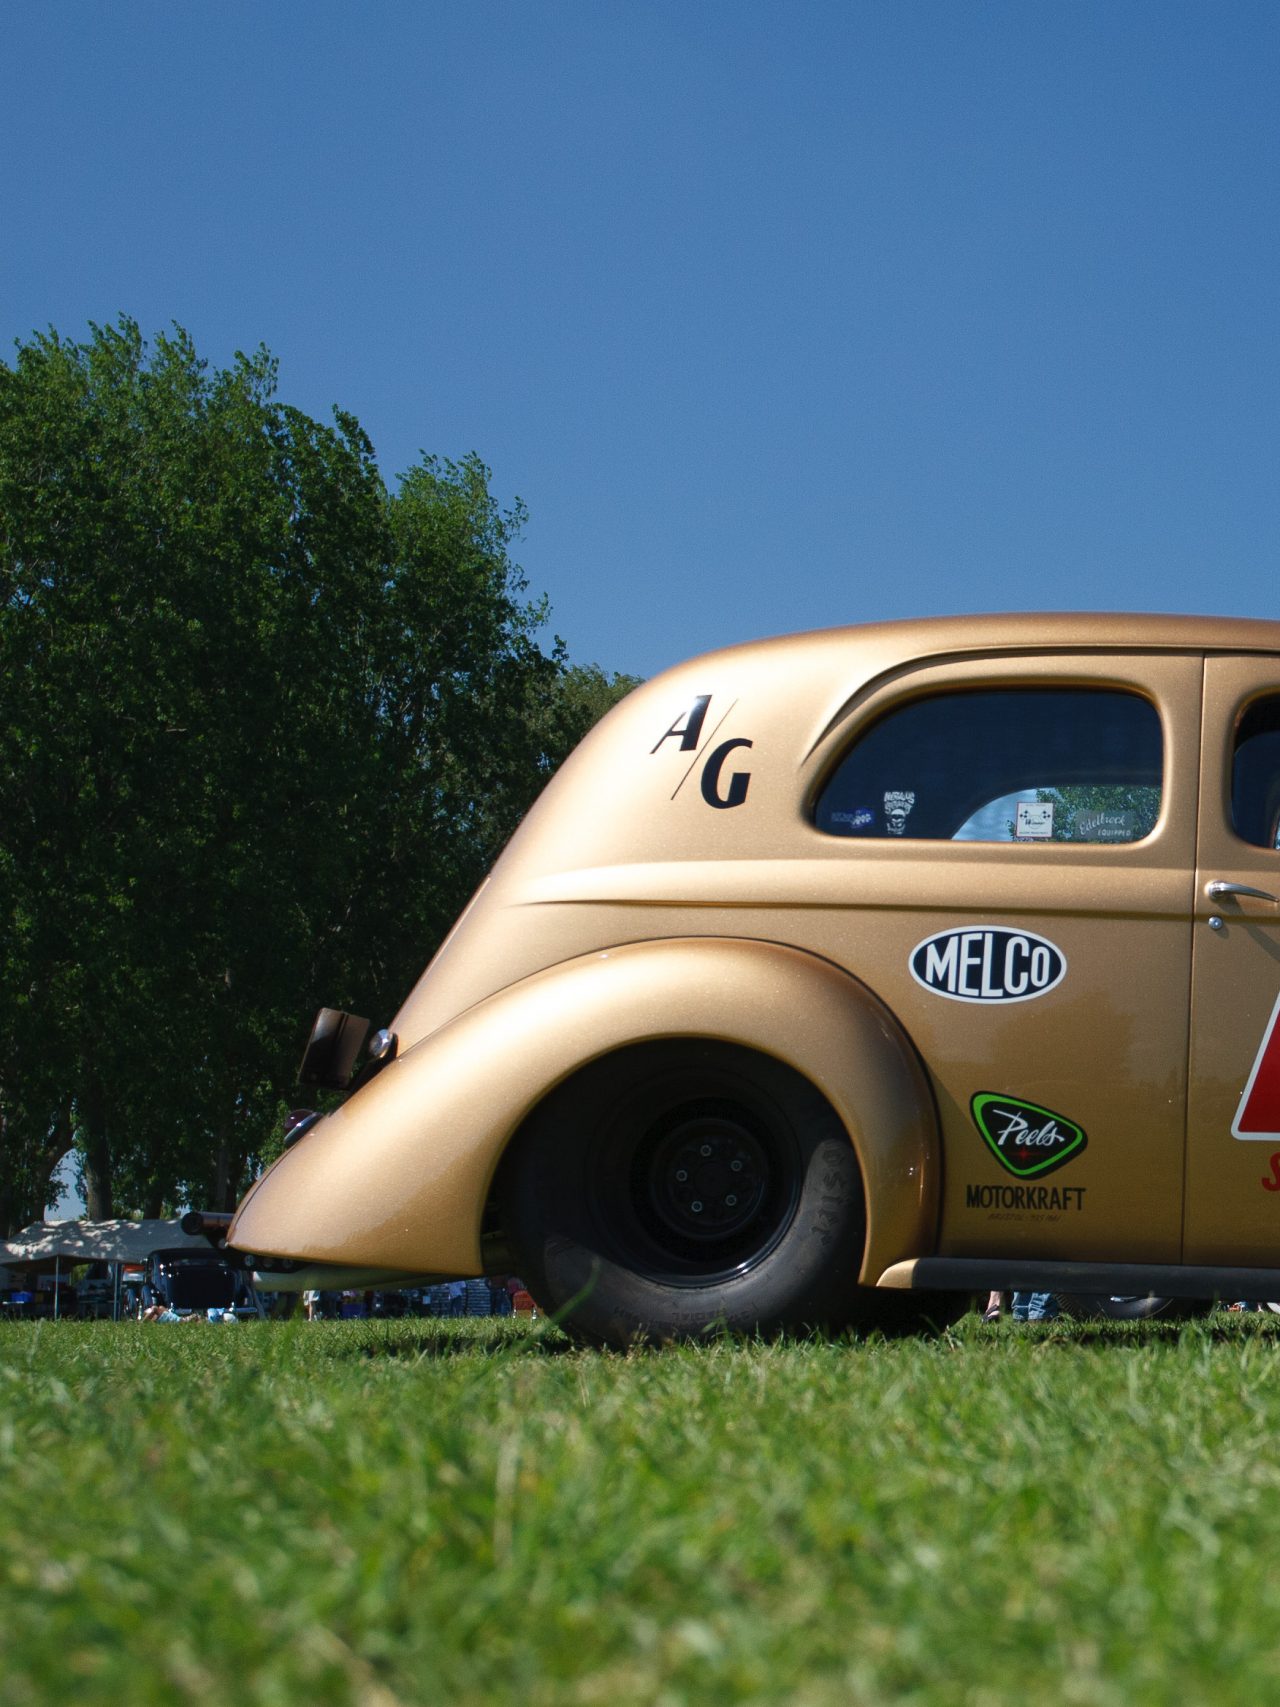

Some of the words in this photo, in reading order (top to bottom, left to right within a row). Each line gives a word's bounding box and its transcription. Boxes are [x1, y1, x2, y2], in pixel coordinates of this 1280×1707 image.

[925, 932, 1051, 998] MELCO
[992, 1109, 1065, 1146] Peels
[966, 1184, 1087, 1211] MOTORKRAFT
